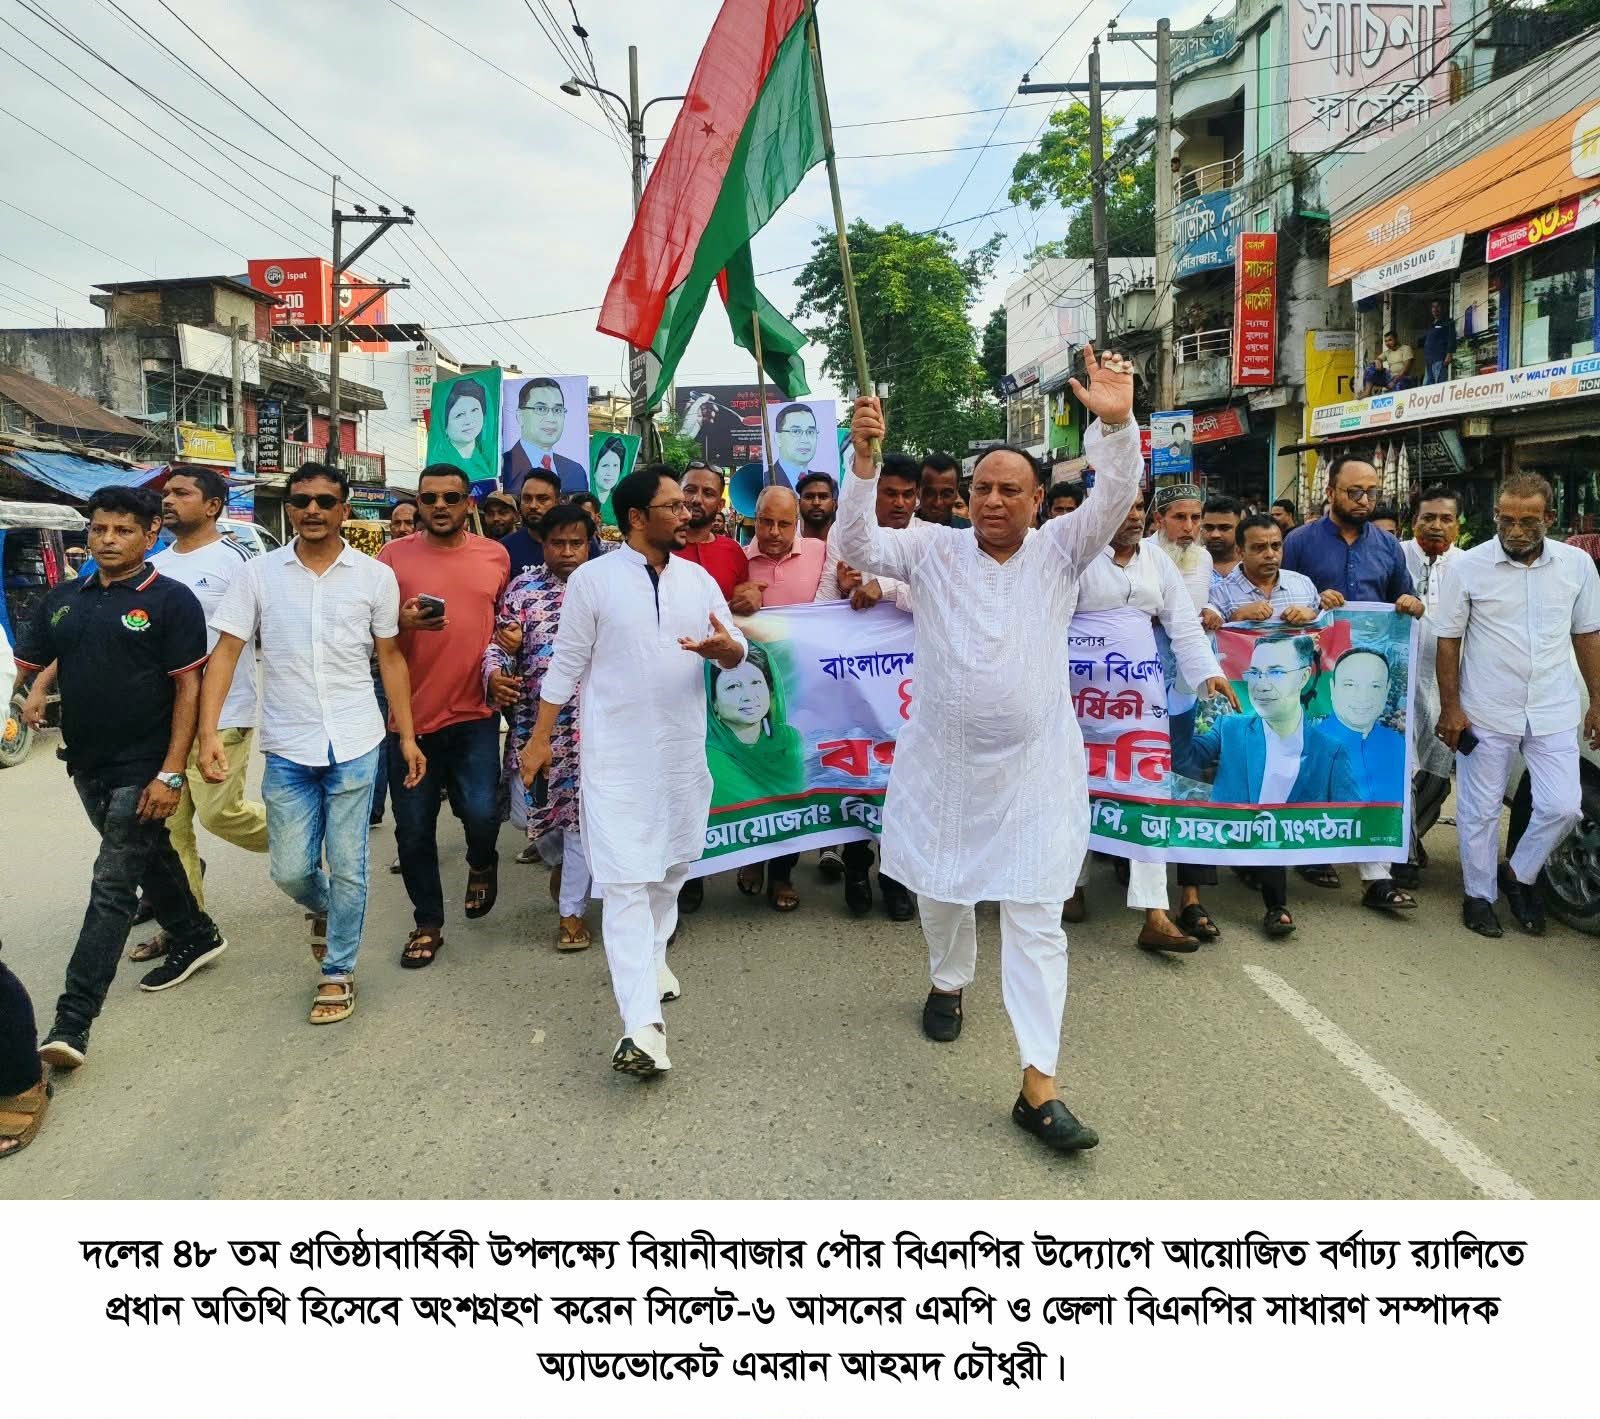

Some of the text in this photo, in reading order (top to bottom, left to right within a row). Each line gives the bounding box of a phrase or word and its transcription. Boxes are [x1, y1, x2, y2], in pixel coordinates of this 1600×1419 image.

[1425, 84, 1534, 162] HONOR
[287, 271, 308, 280] ispat
[1378, 249, 1436, 280] SAMSUNG
[1526, 365, 1567, 381] WALTON
[1408, 382, 1504, 409] Royal Telecom
[1175, 810, 1277, 845] সহযোগী
